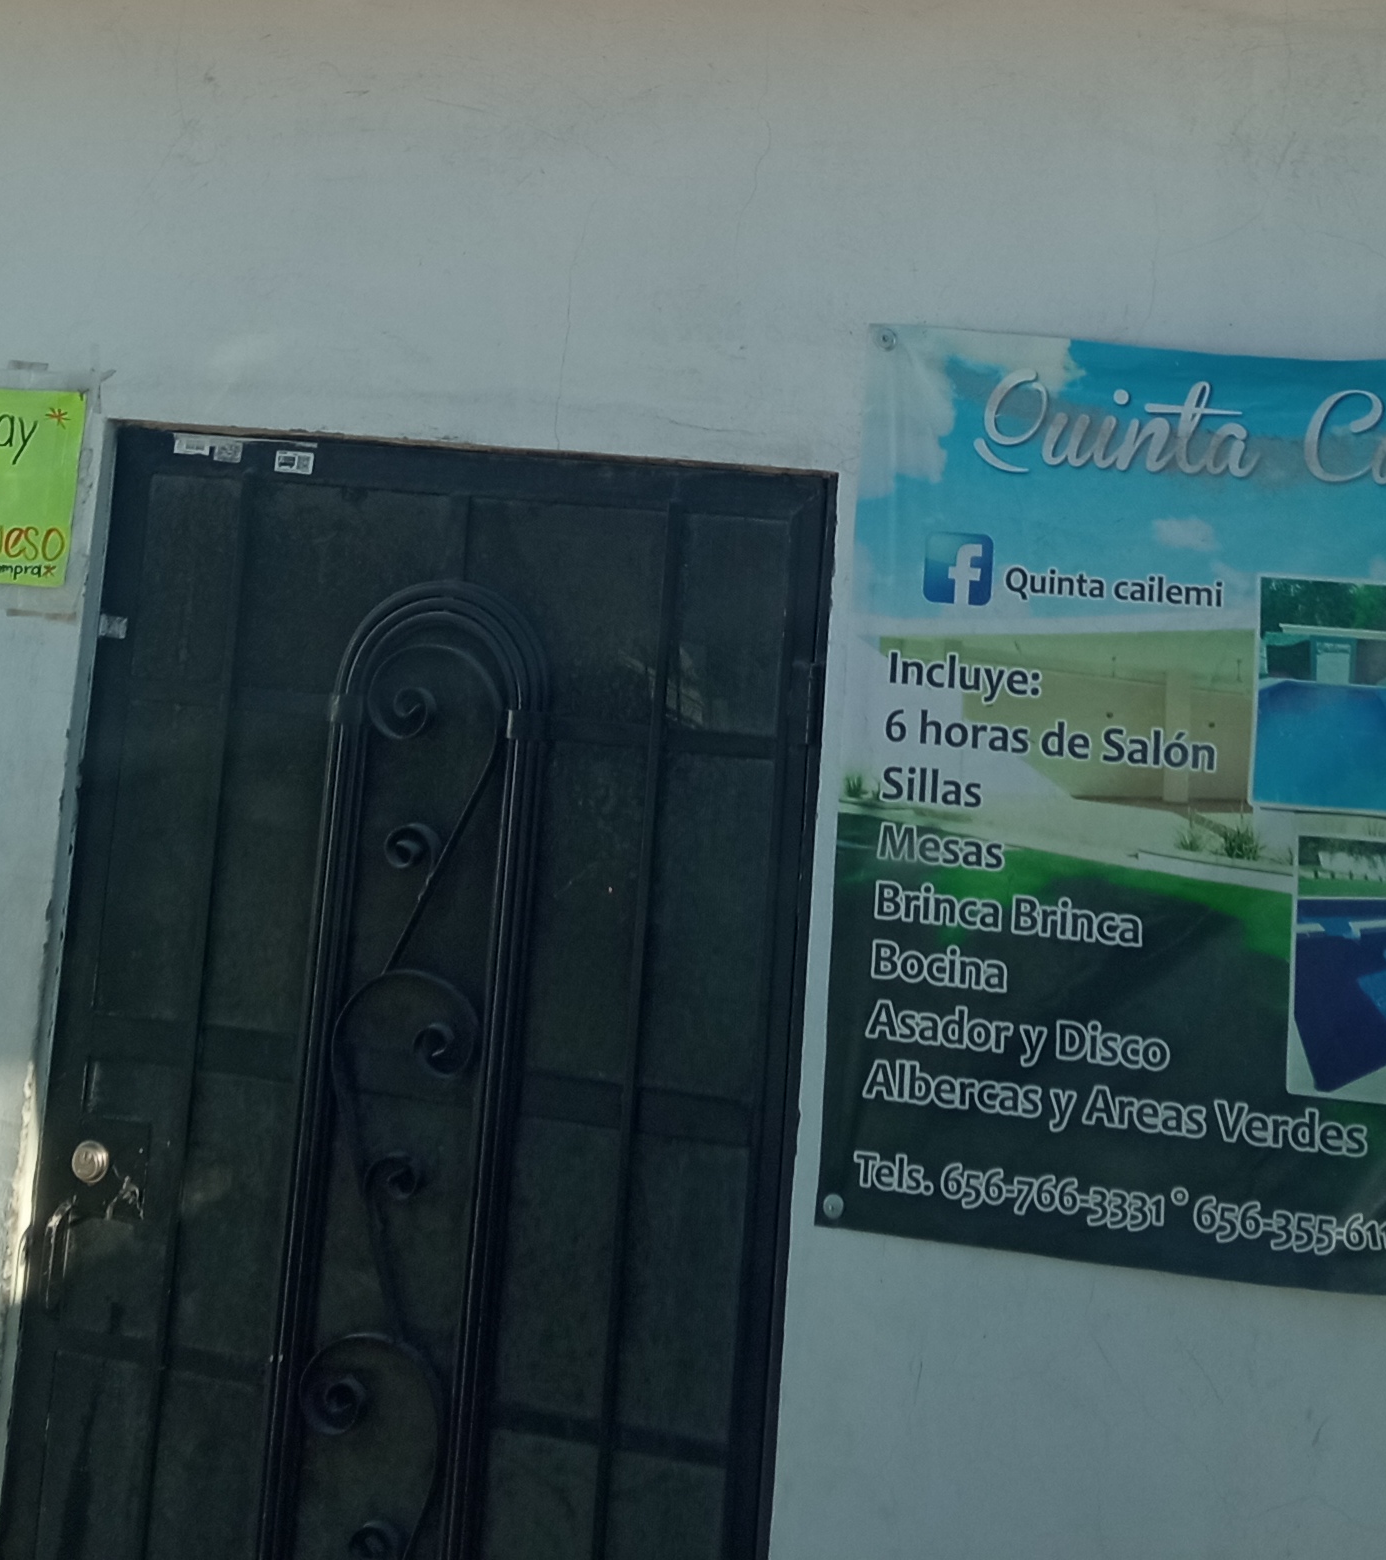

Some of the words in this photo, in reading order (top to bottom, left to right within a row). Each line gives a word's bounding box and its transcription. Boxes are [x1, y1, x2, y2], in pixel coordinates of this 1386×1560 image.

[974, 369, 1260, 477] Quinta
[1004, 566, 1105, 600] Quinta
[1113, 569, 1224, 608] cailemi
[888, 651, 1042, 704] Incluye:
[884, 708, 908, 743] 6
[919, 708, 1030, 756] horas
[1041, 720, 1091, 760] de
[1102, 726, 1217, 772] Salón
[881, 765, 983, 808] Sillas
[877, 822, 1004, 870] Mesas
[874, 880, 1002, 932] Brinca
[1012, 895, 1143, 947] Brinca
[871, 940, 1008, 993] Bocina
[865, 999, 1012, 1053] Asador
[1019, 1025, 1047, 1067] y
[1055, 1021, 1171, 1071] Disco
[863, 1059, 1042, 1117] Albercas
[1049, 1088, 1077, 1132] y
[1083, 1086, 1207, 1138] Areas
[1215, 1100, 1368, 1157] Verdes
[854, 1151, 933, 1196] Tels.
[940, 1163, 1165, 1231] 656-766-3331
